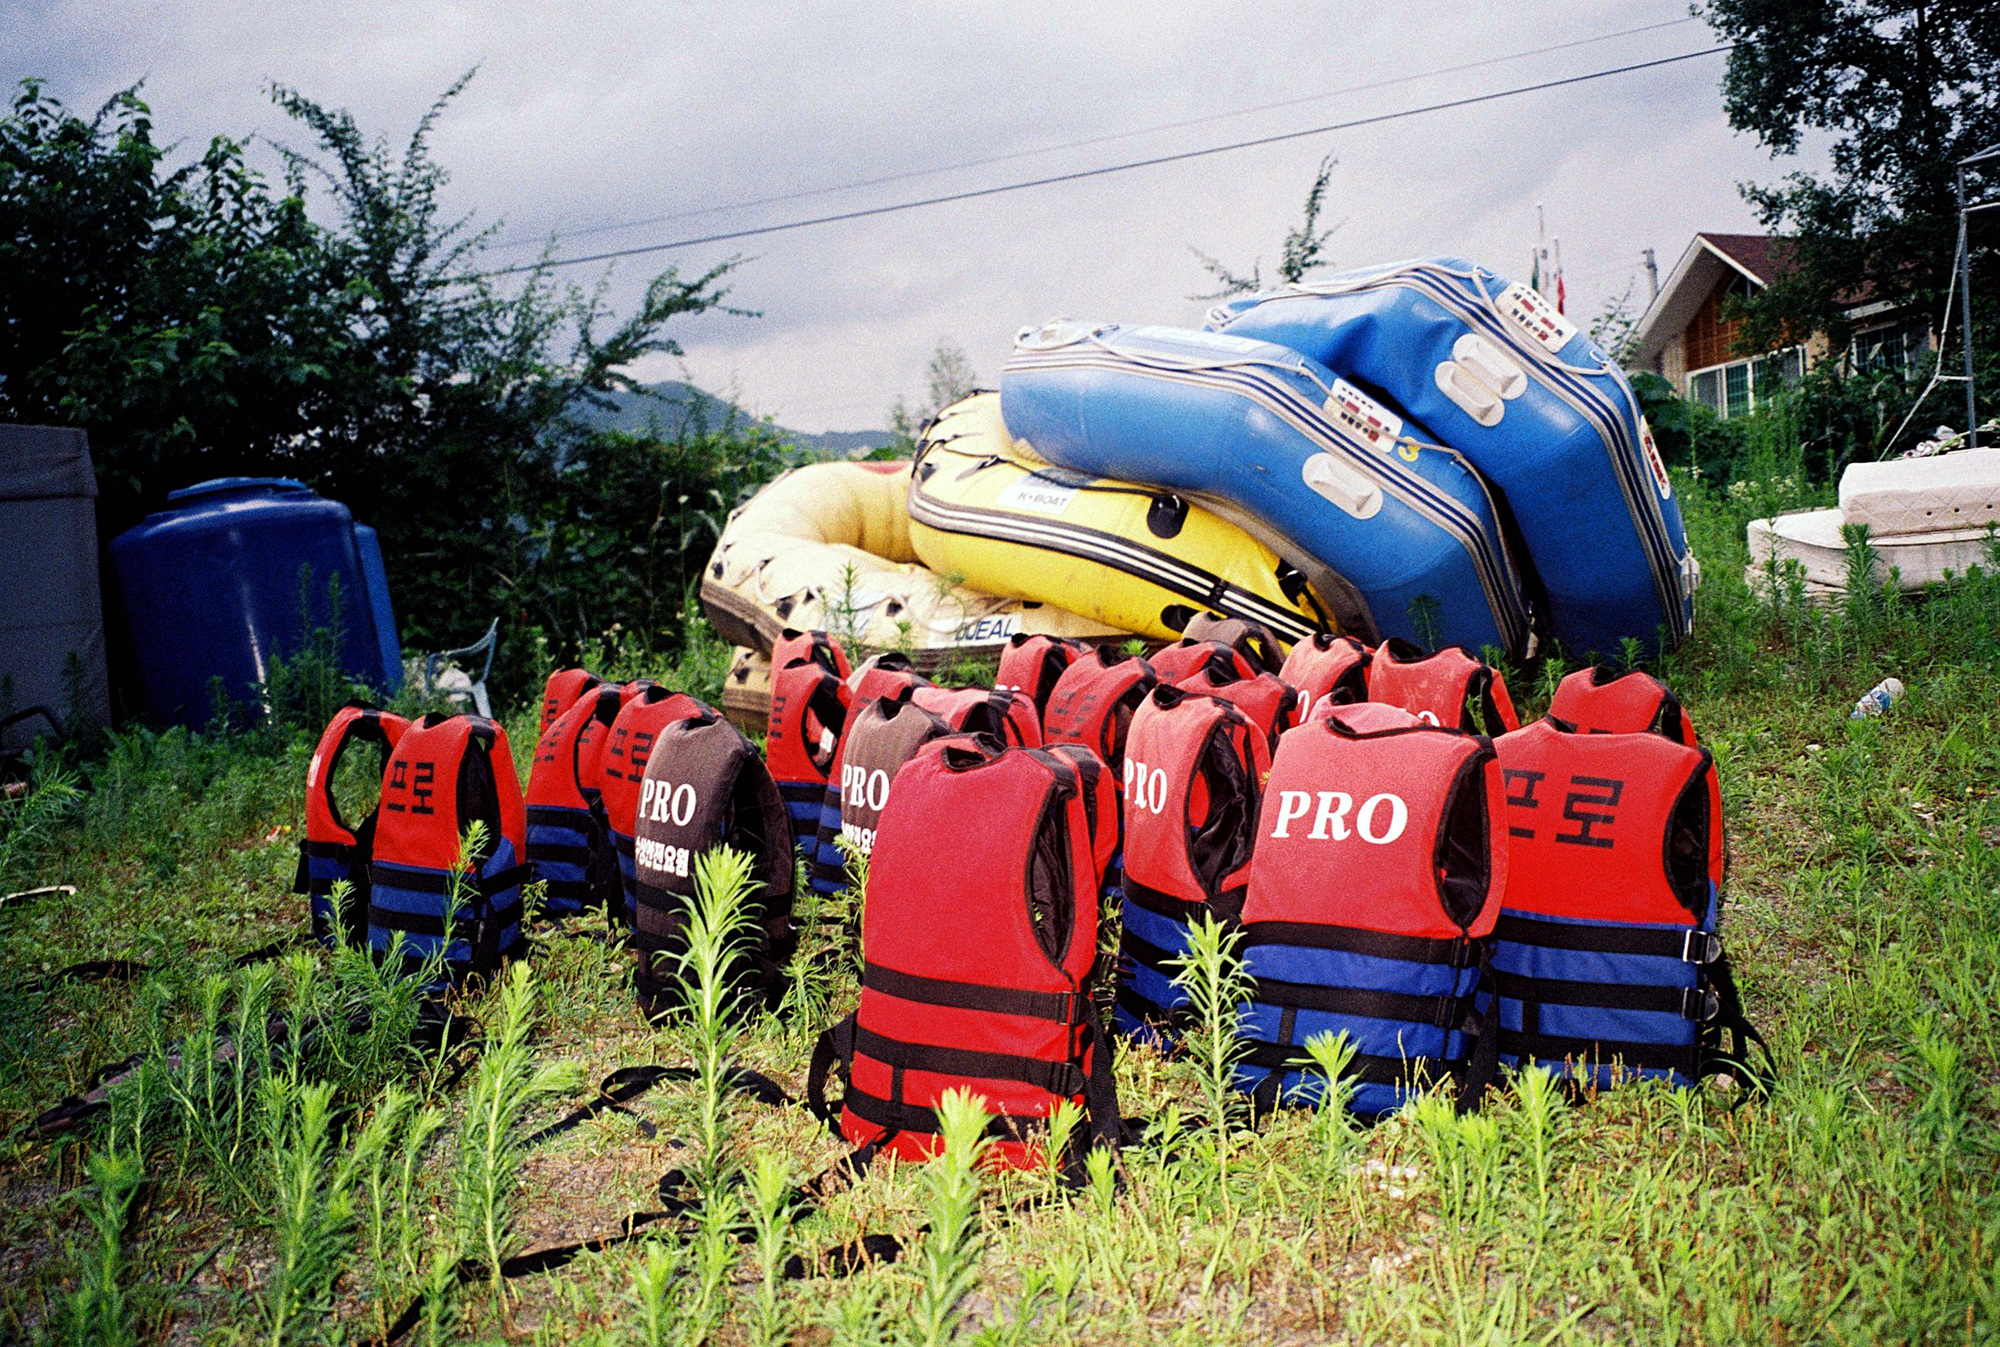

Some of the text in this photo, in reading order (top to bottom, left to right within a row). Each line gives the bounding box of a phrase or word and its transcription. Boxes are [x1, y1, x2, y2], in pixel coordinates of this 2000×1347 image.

[387, 760, 434, 815] 프로
[639, 778, 697, 827] PRO
[841, 763, 890, 812] PRO
[1124, 757, 1168, 815] PRO
[1502, 768, 1625, 849] 프로
[1270, 790, 1408, 845] PRO
